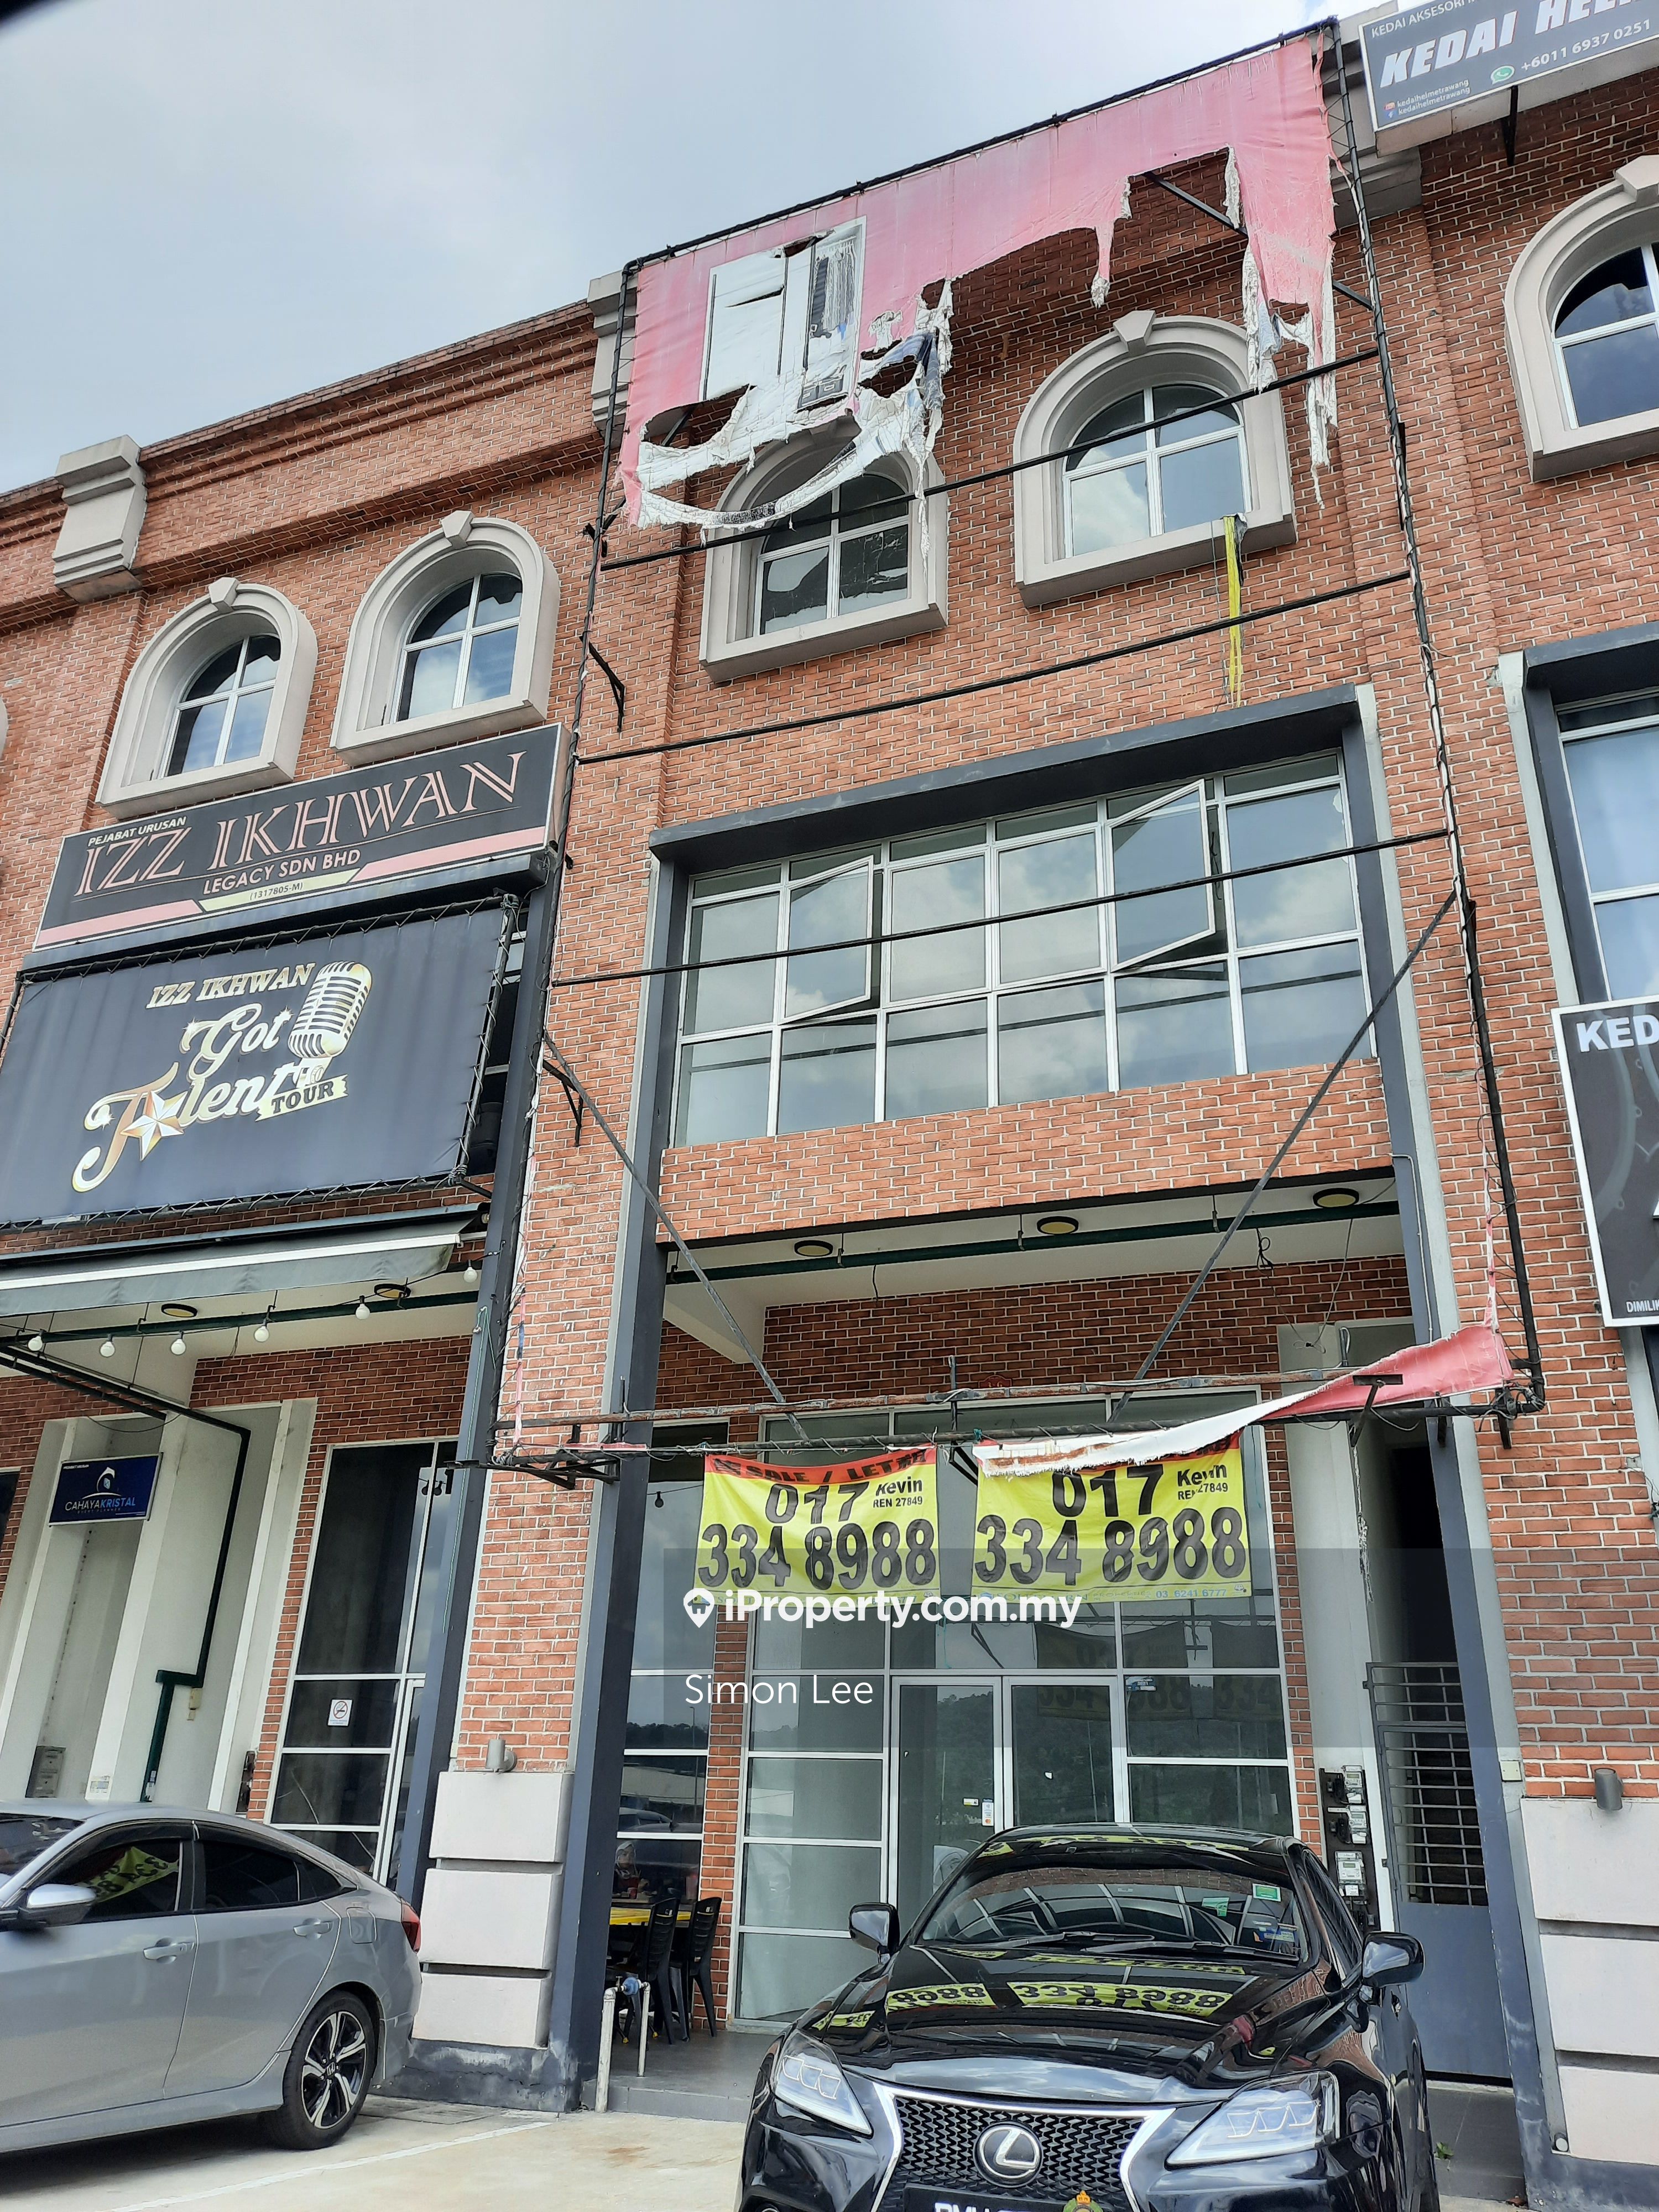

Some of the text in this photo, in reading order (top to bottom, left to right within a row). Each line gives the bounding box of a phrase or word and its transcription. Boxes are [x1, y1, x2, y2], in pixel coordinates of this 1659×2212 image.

[1371, 18, 1406, 38] KEDAI
[1380, 0, 1640, 88] KEDAI HE
[1521, 18, 1650, 71] +6011 6937 0251
[1397, 79, 1469, 107] kedaihelmetrawang
[1398, 87, 1470, 115] kedaihelmetrawang
[74, 751, 527, 896] IZZ IKHWAN
[87, 816, 186, 847] PEJABAT URUSAN
[203, 849, 361, 895] LEGACY SDN BHD
[249, 882, 303, 901] (1317805-M)
[146, 962, 316, 1009] IZZ IKHWAN
[180, 1003, 291, 1082] Got
[1577, 1015, 1659, 1052] KED
[272, 1080, 334, 1113] TOUR
[72, 1057, 301, 1192] Tlent
[847, 1460, 894, 1480] LET
[875, 1477, 922, 1496] Kevin
[765, 1481, 870, 1525] 017
[873, 1496, 922, 1508] REN 27849
[1053, 1464, 1164, 1517] 017
[698, 1519, 936, 1590] 334 8988
[974, 1507, 1246, 1586] 334 8988
[1174, 1589, 1198, 1598] 6241
[1202, 1589, 1227, 1597] 6777
